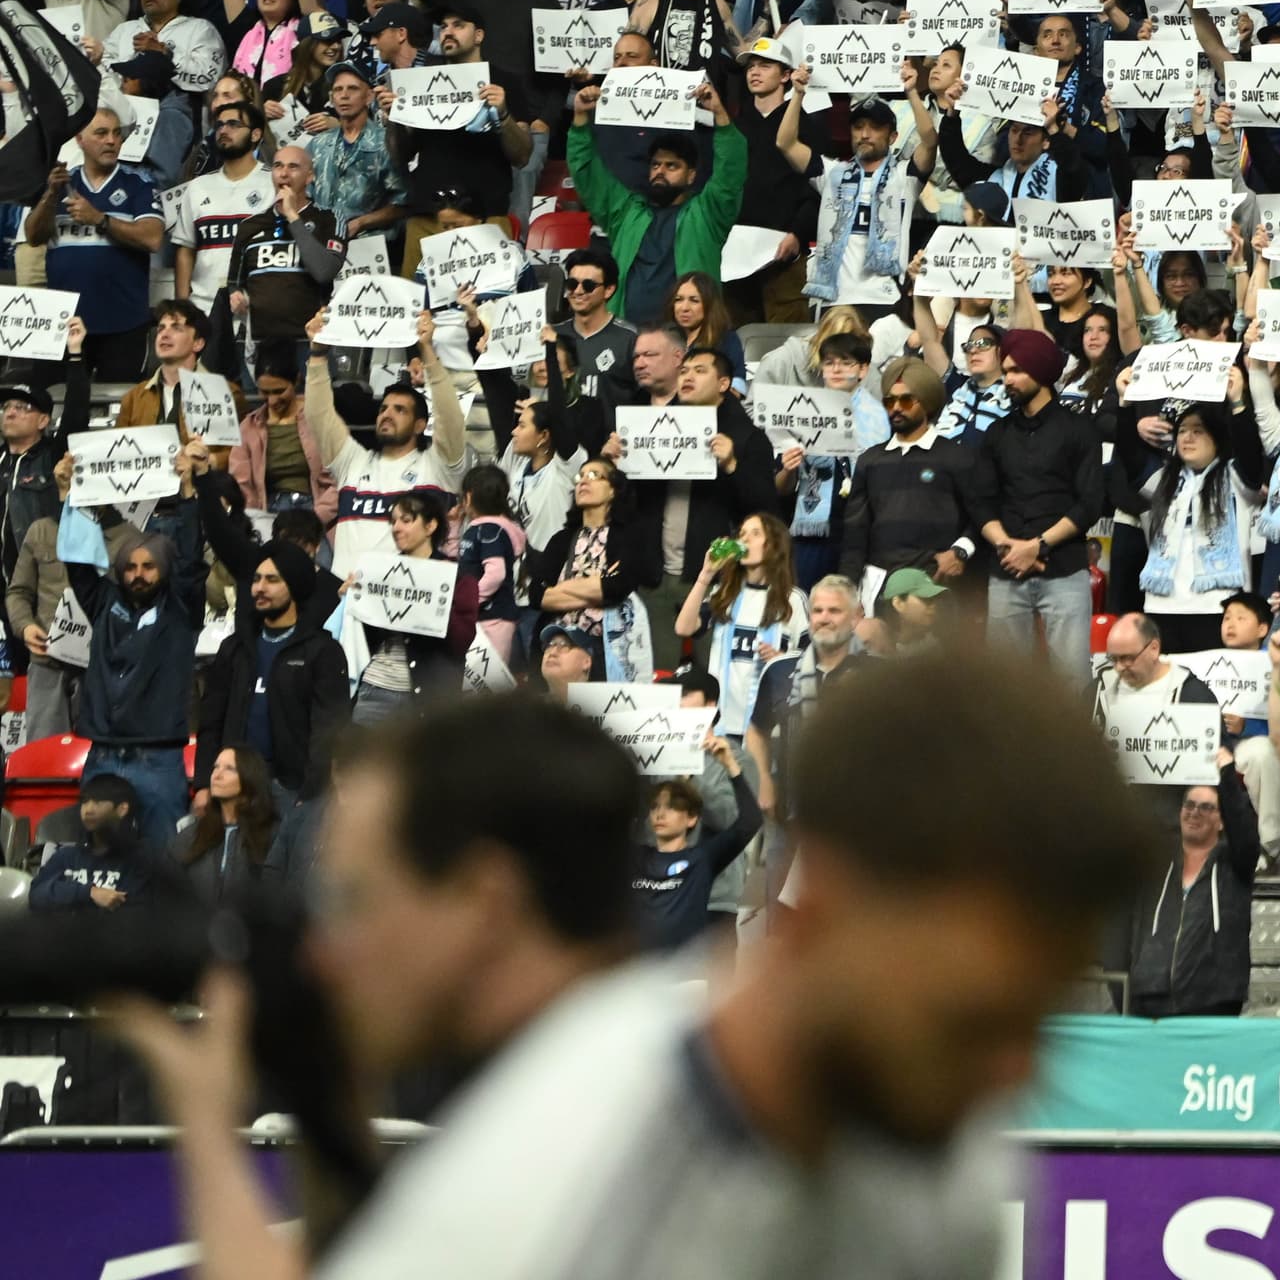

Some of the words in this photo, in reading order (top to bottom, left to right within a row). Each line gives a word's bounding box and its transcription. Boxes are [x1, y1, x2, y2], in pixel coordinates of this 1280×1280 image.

[819, 52, 842, 65] SAVE
[860, 51, 885, 64] CAPS
[1149, 208, 1171, 222] SAVE
[1187, 208, 1212, 221] CAPS
[198, 223, 239, 239] TEL
[257, 243, 300, 268] Bell
[89, 459, 115, 474] SAVE
[134, 454, 162, 470] CAPS
[352, 498, 393, 514] TEL
[1180, 1064, 1256, 1121] Sing
